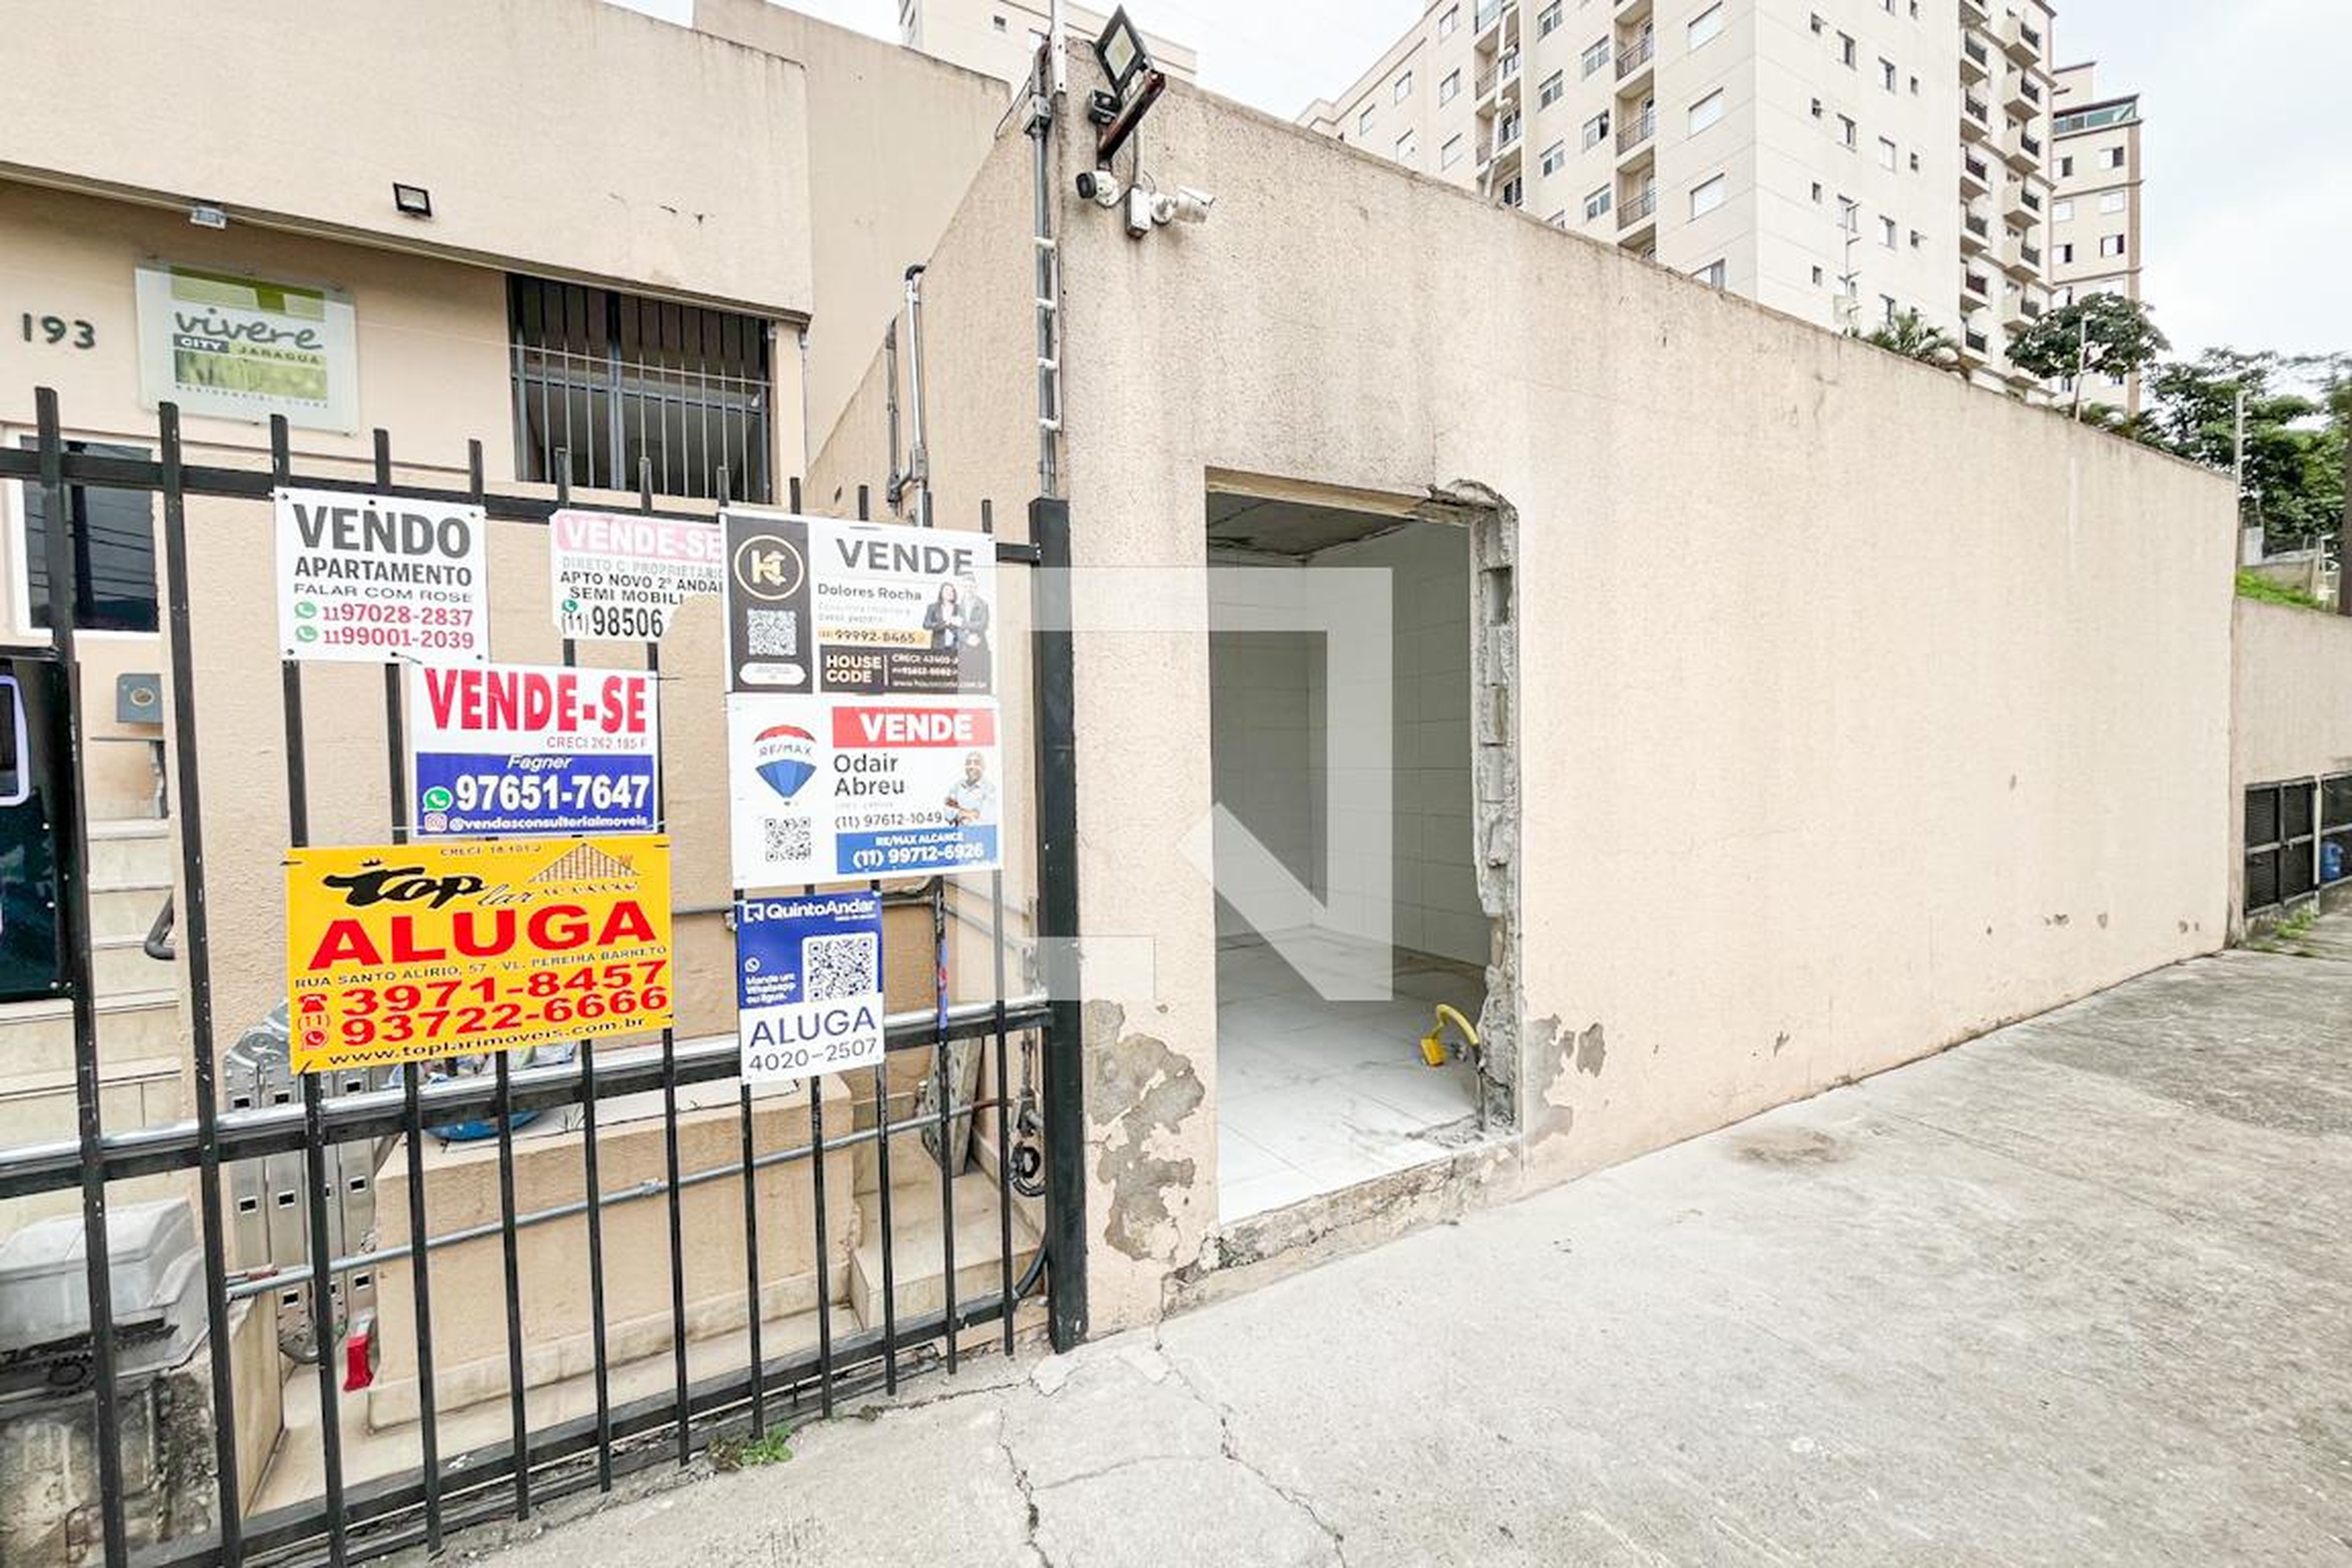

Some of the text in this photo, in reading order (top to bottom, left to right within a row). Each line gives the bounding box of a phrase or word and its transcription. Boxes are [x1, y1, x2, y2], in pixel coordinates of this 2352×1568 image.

[23, 313, 95, 349] 193
[175, 307, 323, 350] vivere
[181, 338, 222, 351] CITY
[292, 503, 470, 558] VENDO
[295, 557, 472, 586] APARTAMENTO
[835, 538, 973, 577] VENDE
[294, 584, 473, 603] FALAR COM ROSE
[560, 571, 603, 585] APTO
[609, 573, 652, 589] NOVO
[570, 586, 615, 601] SEMI
[818, 583, 921, 601] Dolores Rocha
[592, 605, 664, 638] 98506
[826, 655, 882, 669] HOUSE
[826, 669, 872, 683] CODE
[424, 668, 646, 733] VENDE-SE
[859, 714, 973, 742] VENDE
[507, 754, 572, 772] Fagner
[760, 743, 812, 757] RE/MAX
[834, 753, 899, 774] Odair
[456, 774, 650, 811] 97651-7647
[834, 777, 905, 797] Abreu
[835, 812, 942, 829] (11) 97612-1049
[853, 843, 984, 867] (11) 99712-6926
[323, 866, 483, 909] top
[766, 898, 876, 919] QuintoAndar
[307, 900, 657, 971] ALUGA
[295, 976, 331, 988] RUA
[337, 971, 395, 984] SANTO
[469, 963, 486, 972] 57
[532, 952, 596, 968] PEREIRA
[602, 946, 667, 960] BARRETO
[342, 960, 666, 1018] 3971-8457
[297, 1014, 331, 1031] (11)
[341, 986, 668, 1048] 93722-6666
[749, 1006, 876, 1048] ALUGA
[328, 1016, 646, 1066] www.toplarimoveis.com.br
[749, 1038, 876, 1071] 4020-2507
